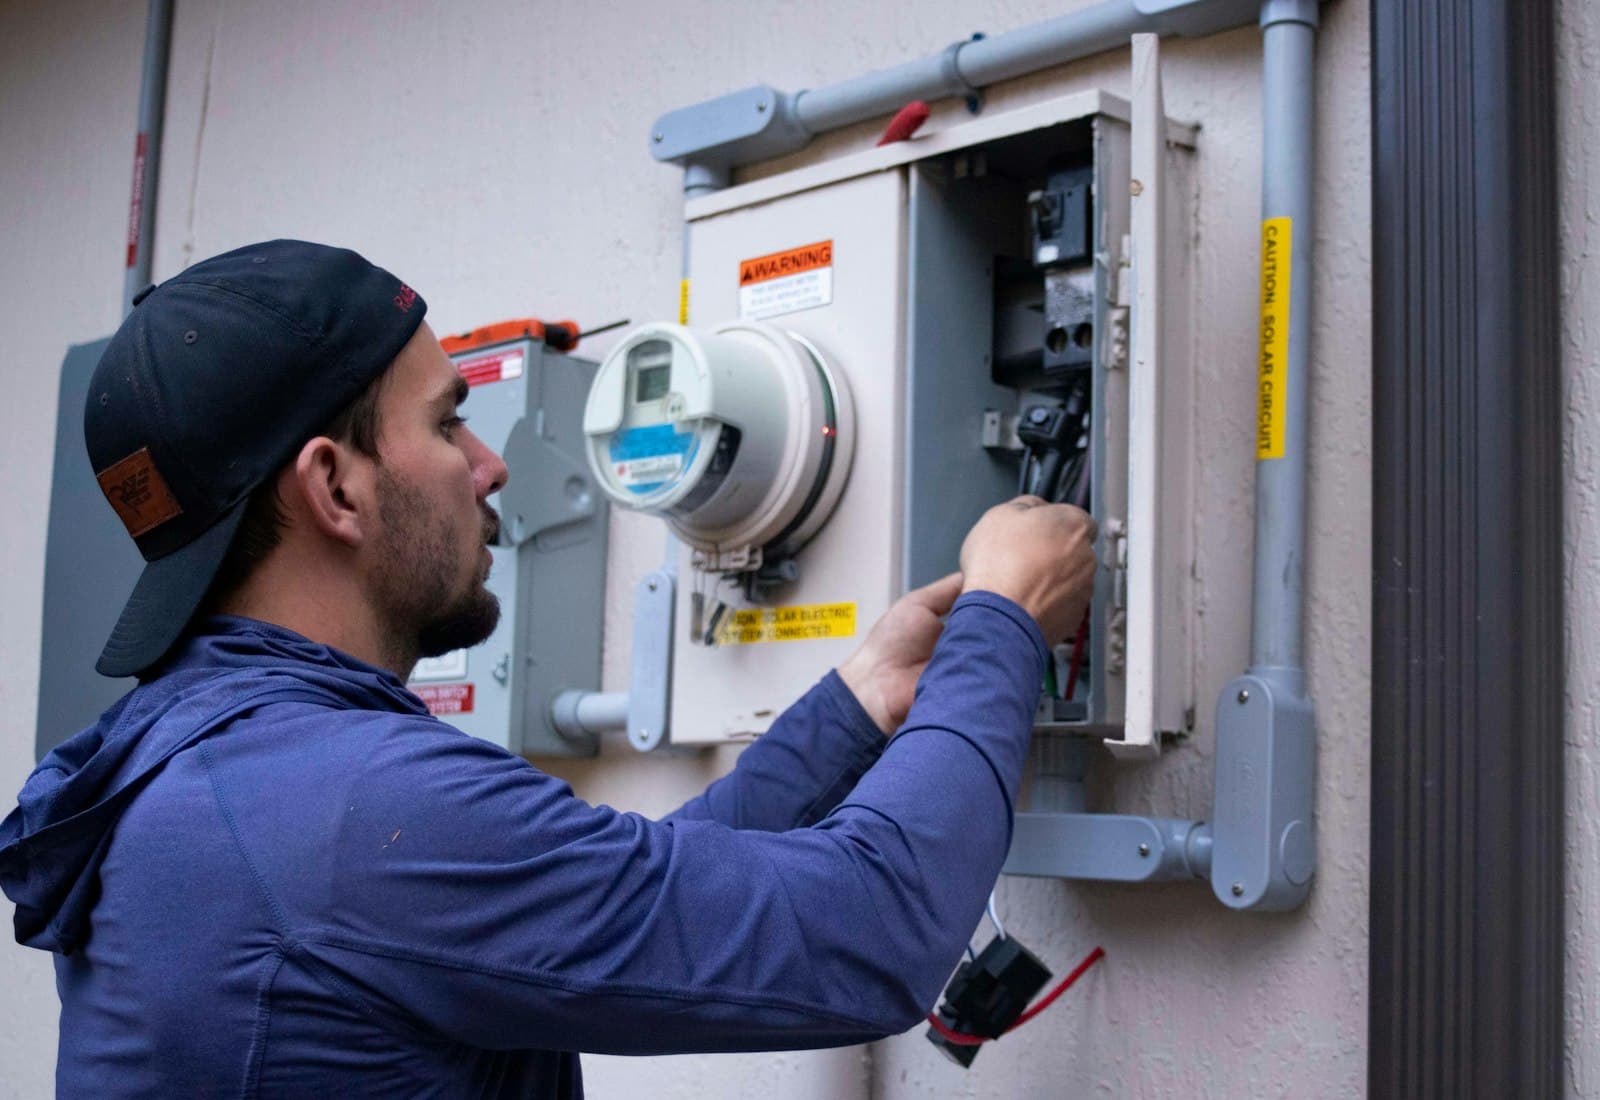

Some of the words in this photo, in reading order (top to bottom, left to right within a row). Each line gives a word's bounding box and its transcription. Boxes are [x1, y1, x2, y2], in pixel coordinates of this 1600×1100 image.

[755, 246, 832, 276] WARNING
[1263, 315, 1275, 375] SOLAR
[1260, 381, 1273, 451] CIRCUIT
[800, 607, 851, 621] ELECTRIC
